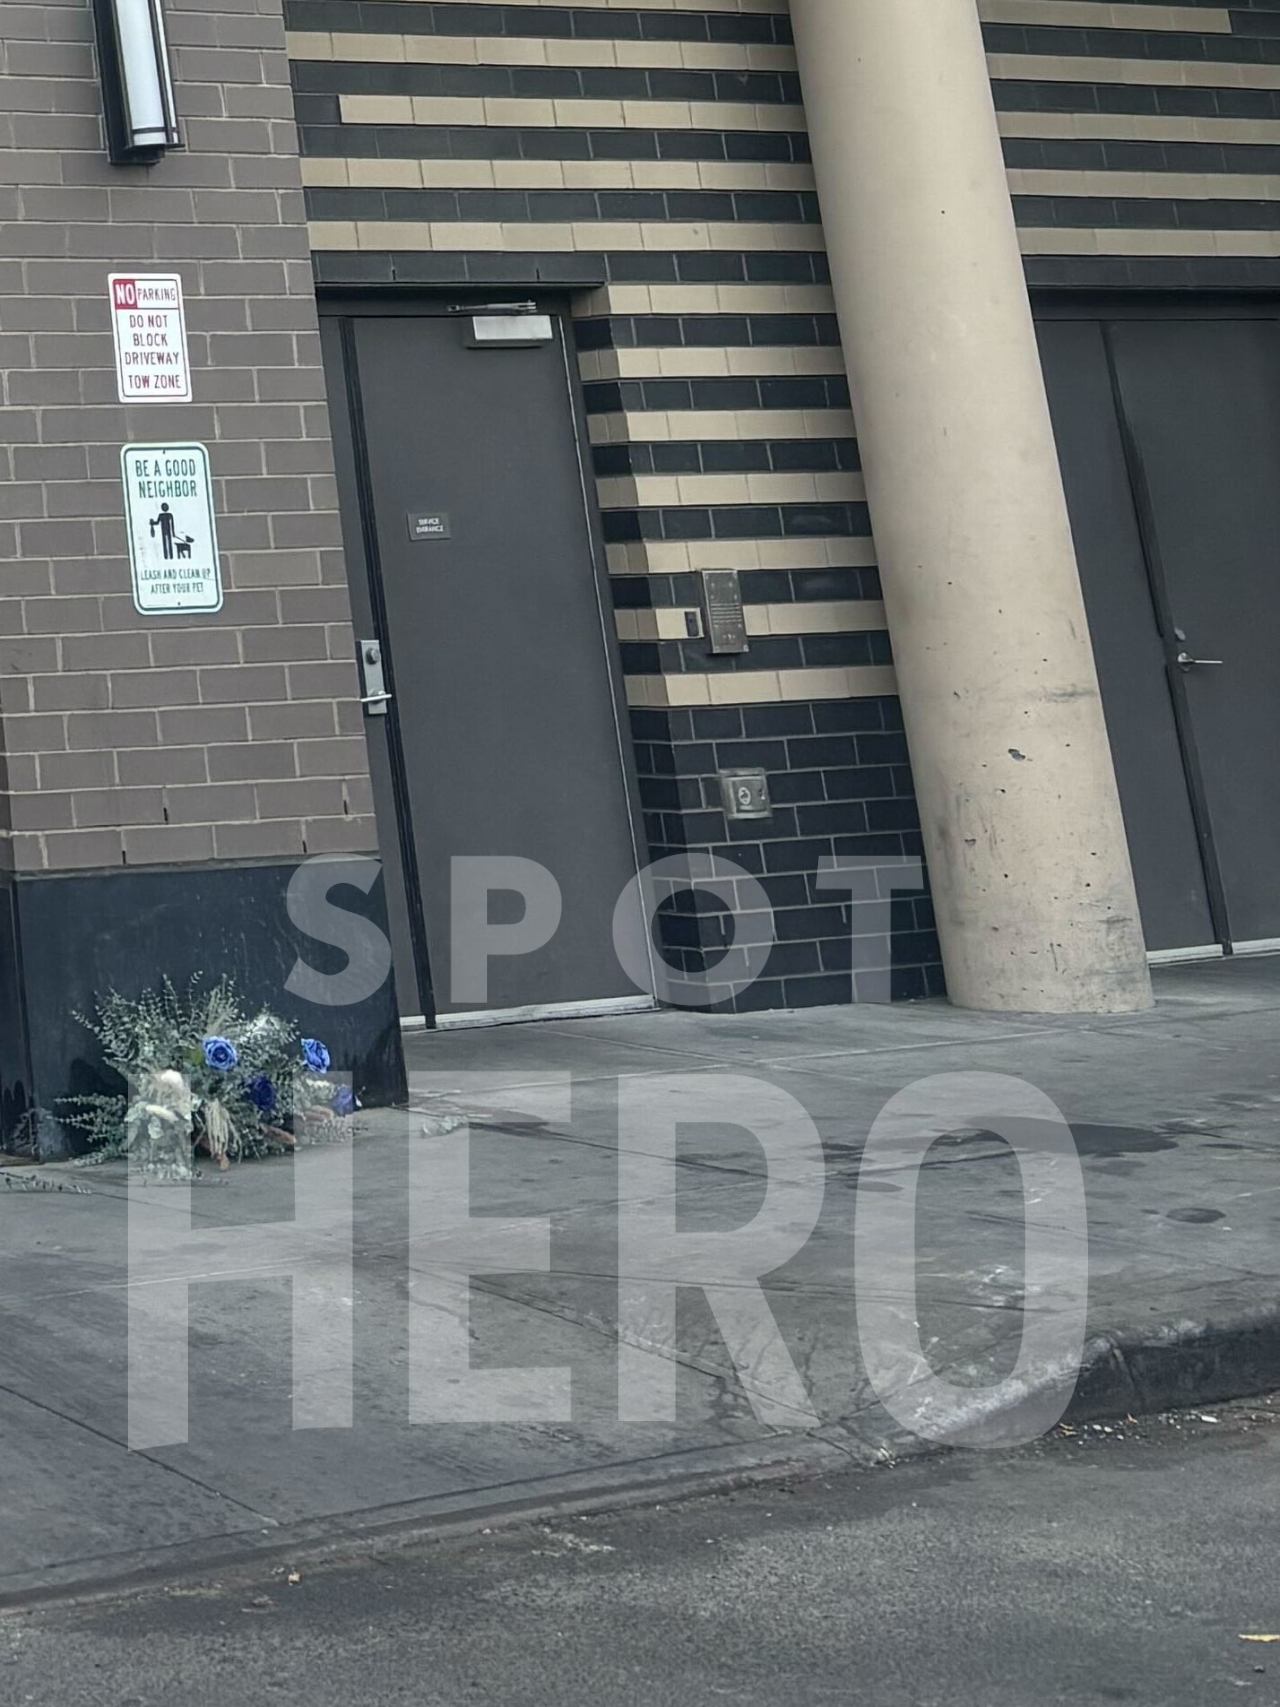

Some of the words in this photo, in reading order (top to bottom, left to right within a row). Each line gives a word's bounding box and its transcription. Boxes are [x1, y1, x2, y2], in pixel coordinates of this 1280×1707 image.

[114, 283, 136, 305] NO
[137, 288, 177, 301] PARKING
[129, 314, 144, 328] DO
[147, 314, 168, 328] NOT
[133, 333, 168, 347] BLOCK
[124, 352, 180, 365] DRIVEWAY
[128, 374, 150, 389] TOW
[154, 374, 182, 389] ZONE
[135, 459, 150, 478] BE
[153, 459, 162, 477] A
[165, 458, 196, 477] GOOD
[138, 479, 198, 499] NEIGHBOR
[140, 569, 162, 581] LEASH
[163, 569, 177, 580] AND
[178, 568, 200, 580] CLEAN
[150, 583, 171, 595] AFTER
[172, 582, 191, 594] YOUR
[192, 581, 204, 593] PET
